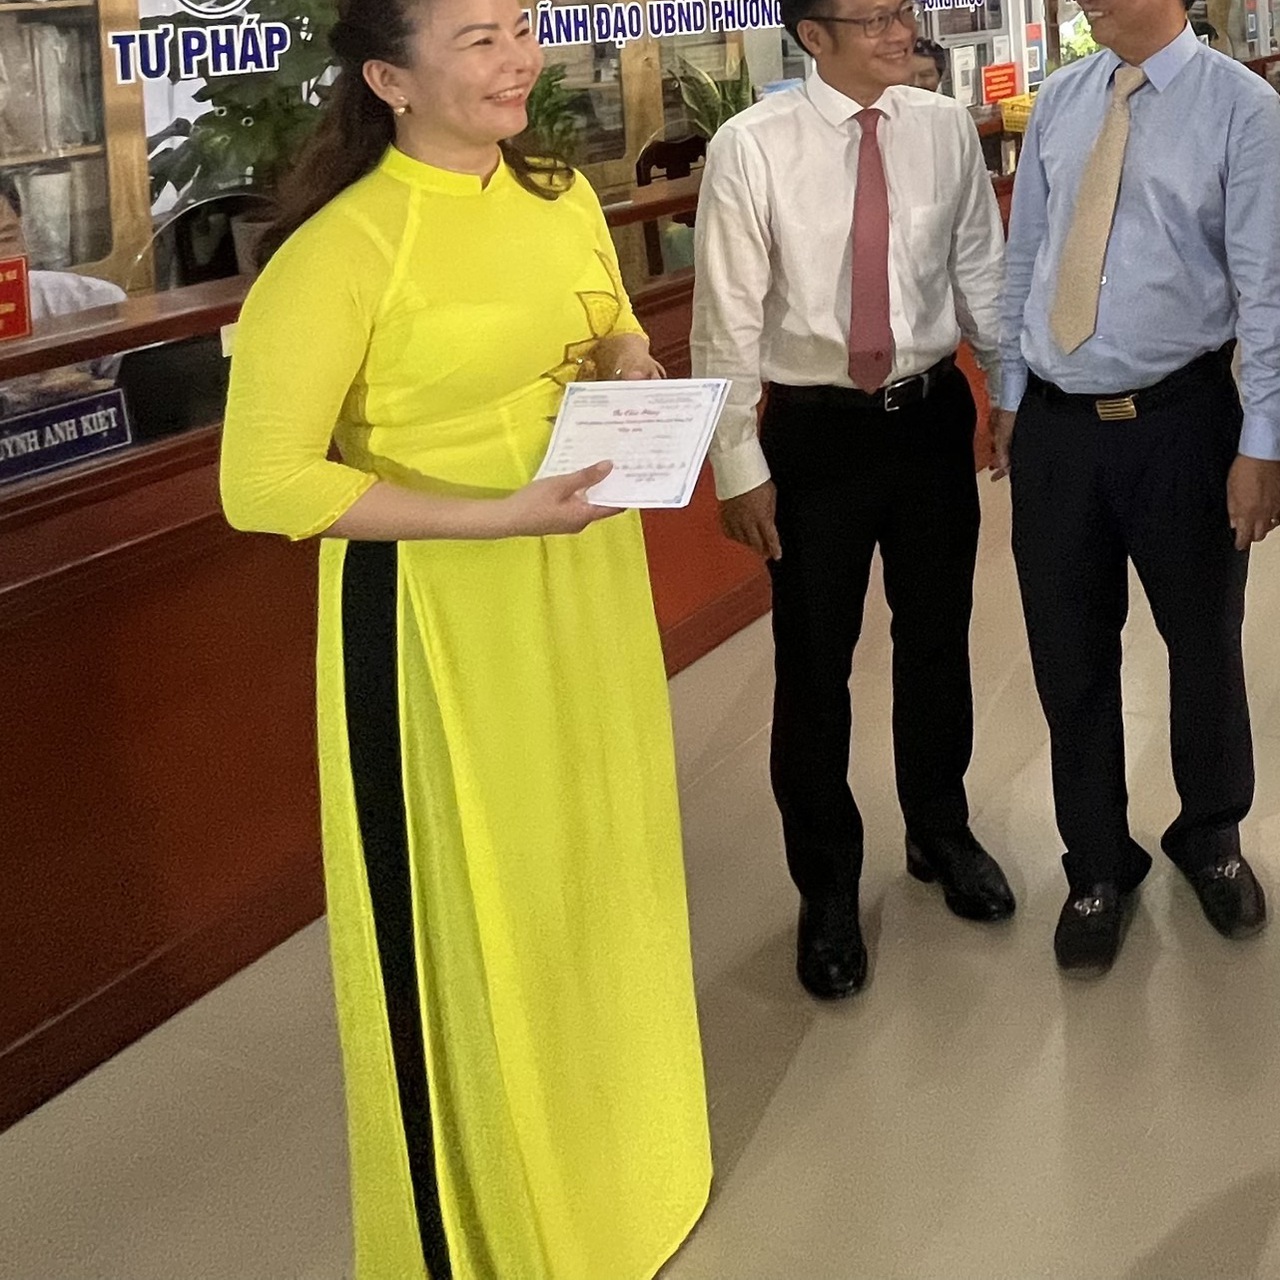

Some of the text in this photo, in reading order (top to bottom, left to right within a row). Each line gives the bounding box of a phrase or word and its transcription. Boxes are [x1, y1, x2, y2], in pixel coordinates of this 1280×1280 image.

[523, 0, 590, 47] ÃNH
[594, 2, 642, 48] ĐẠO
[111, 15, 290, 83] TƯ PHÁP
[44, 418, 79, 448] ANH
[80, 405, 118, 437] KIỆT
